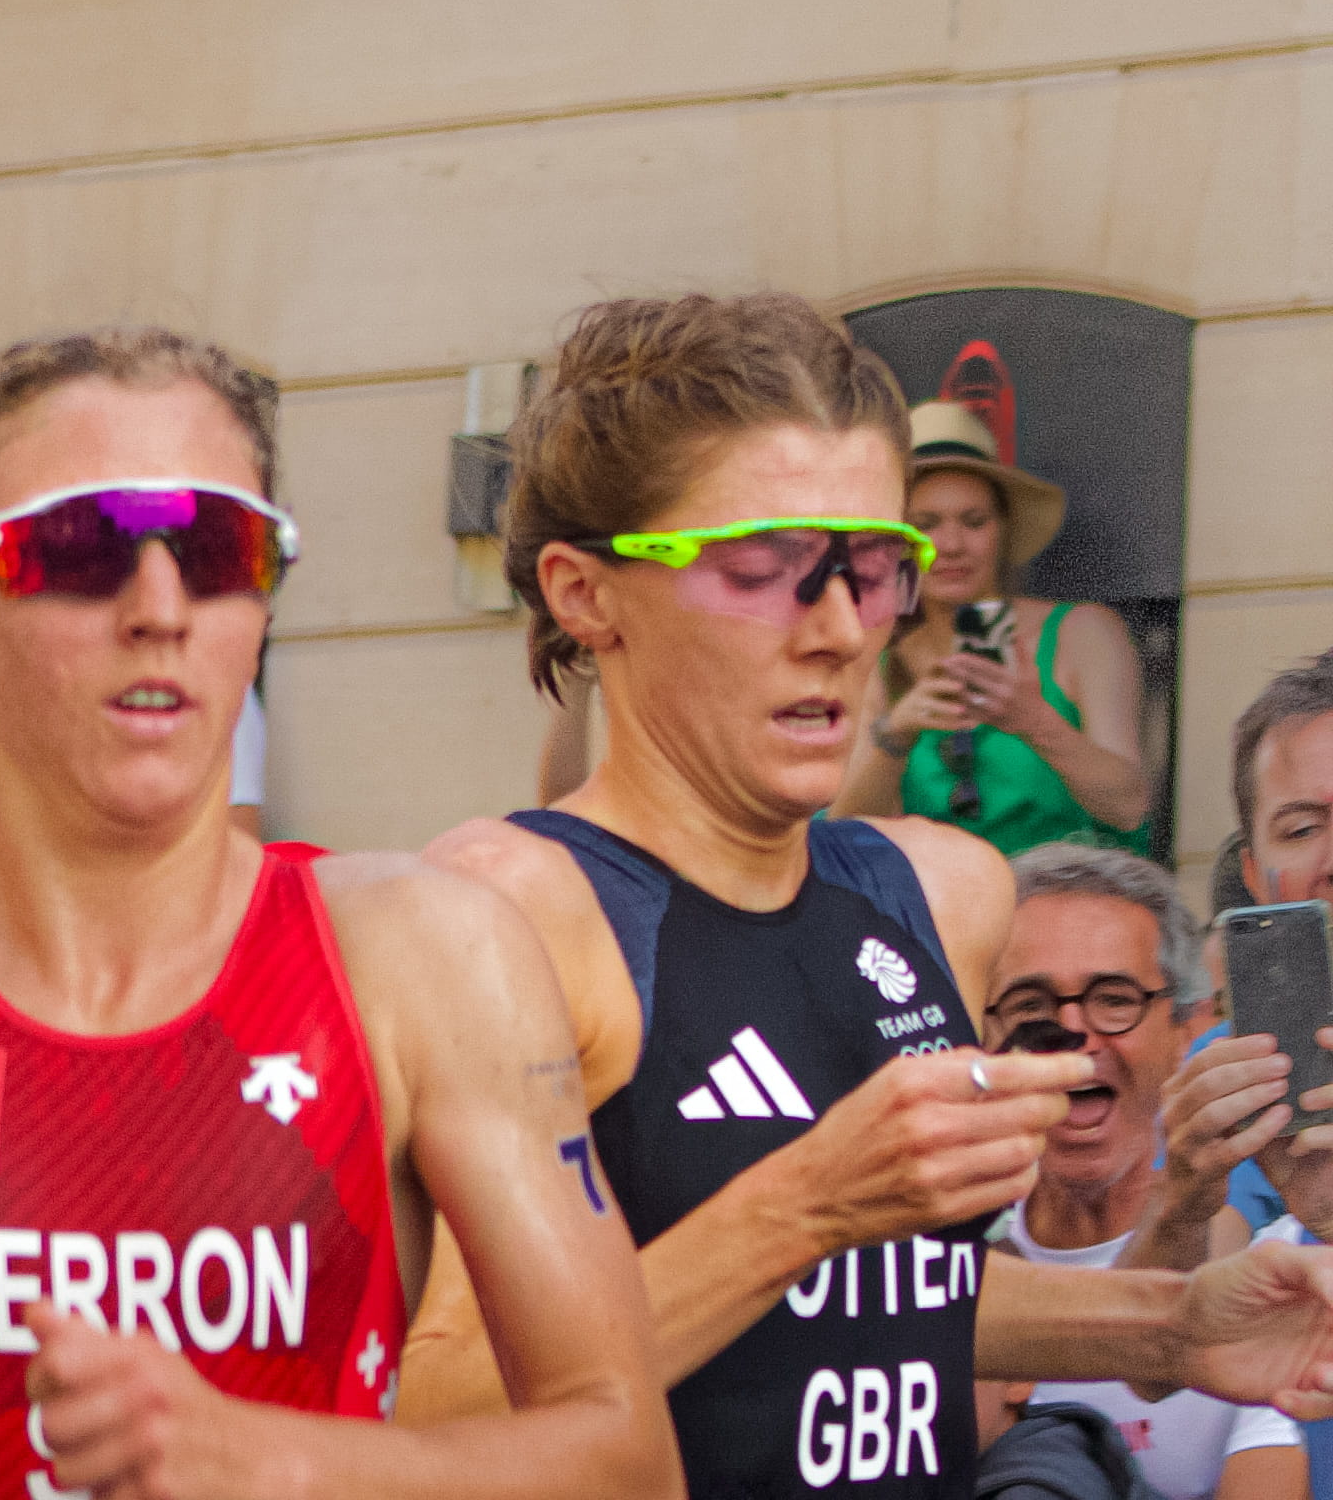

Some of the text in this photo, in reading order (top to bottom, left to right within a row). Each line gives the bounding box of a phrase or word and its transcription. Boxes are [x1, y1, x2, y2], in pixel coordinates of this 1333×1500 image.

[875, 1004, 946, 1040] TEAM GB
[559, 1134, 605, 1215] 7
[797, 1361, 938, 1488] GBR
